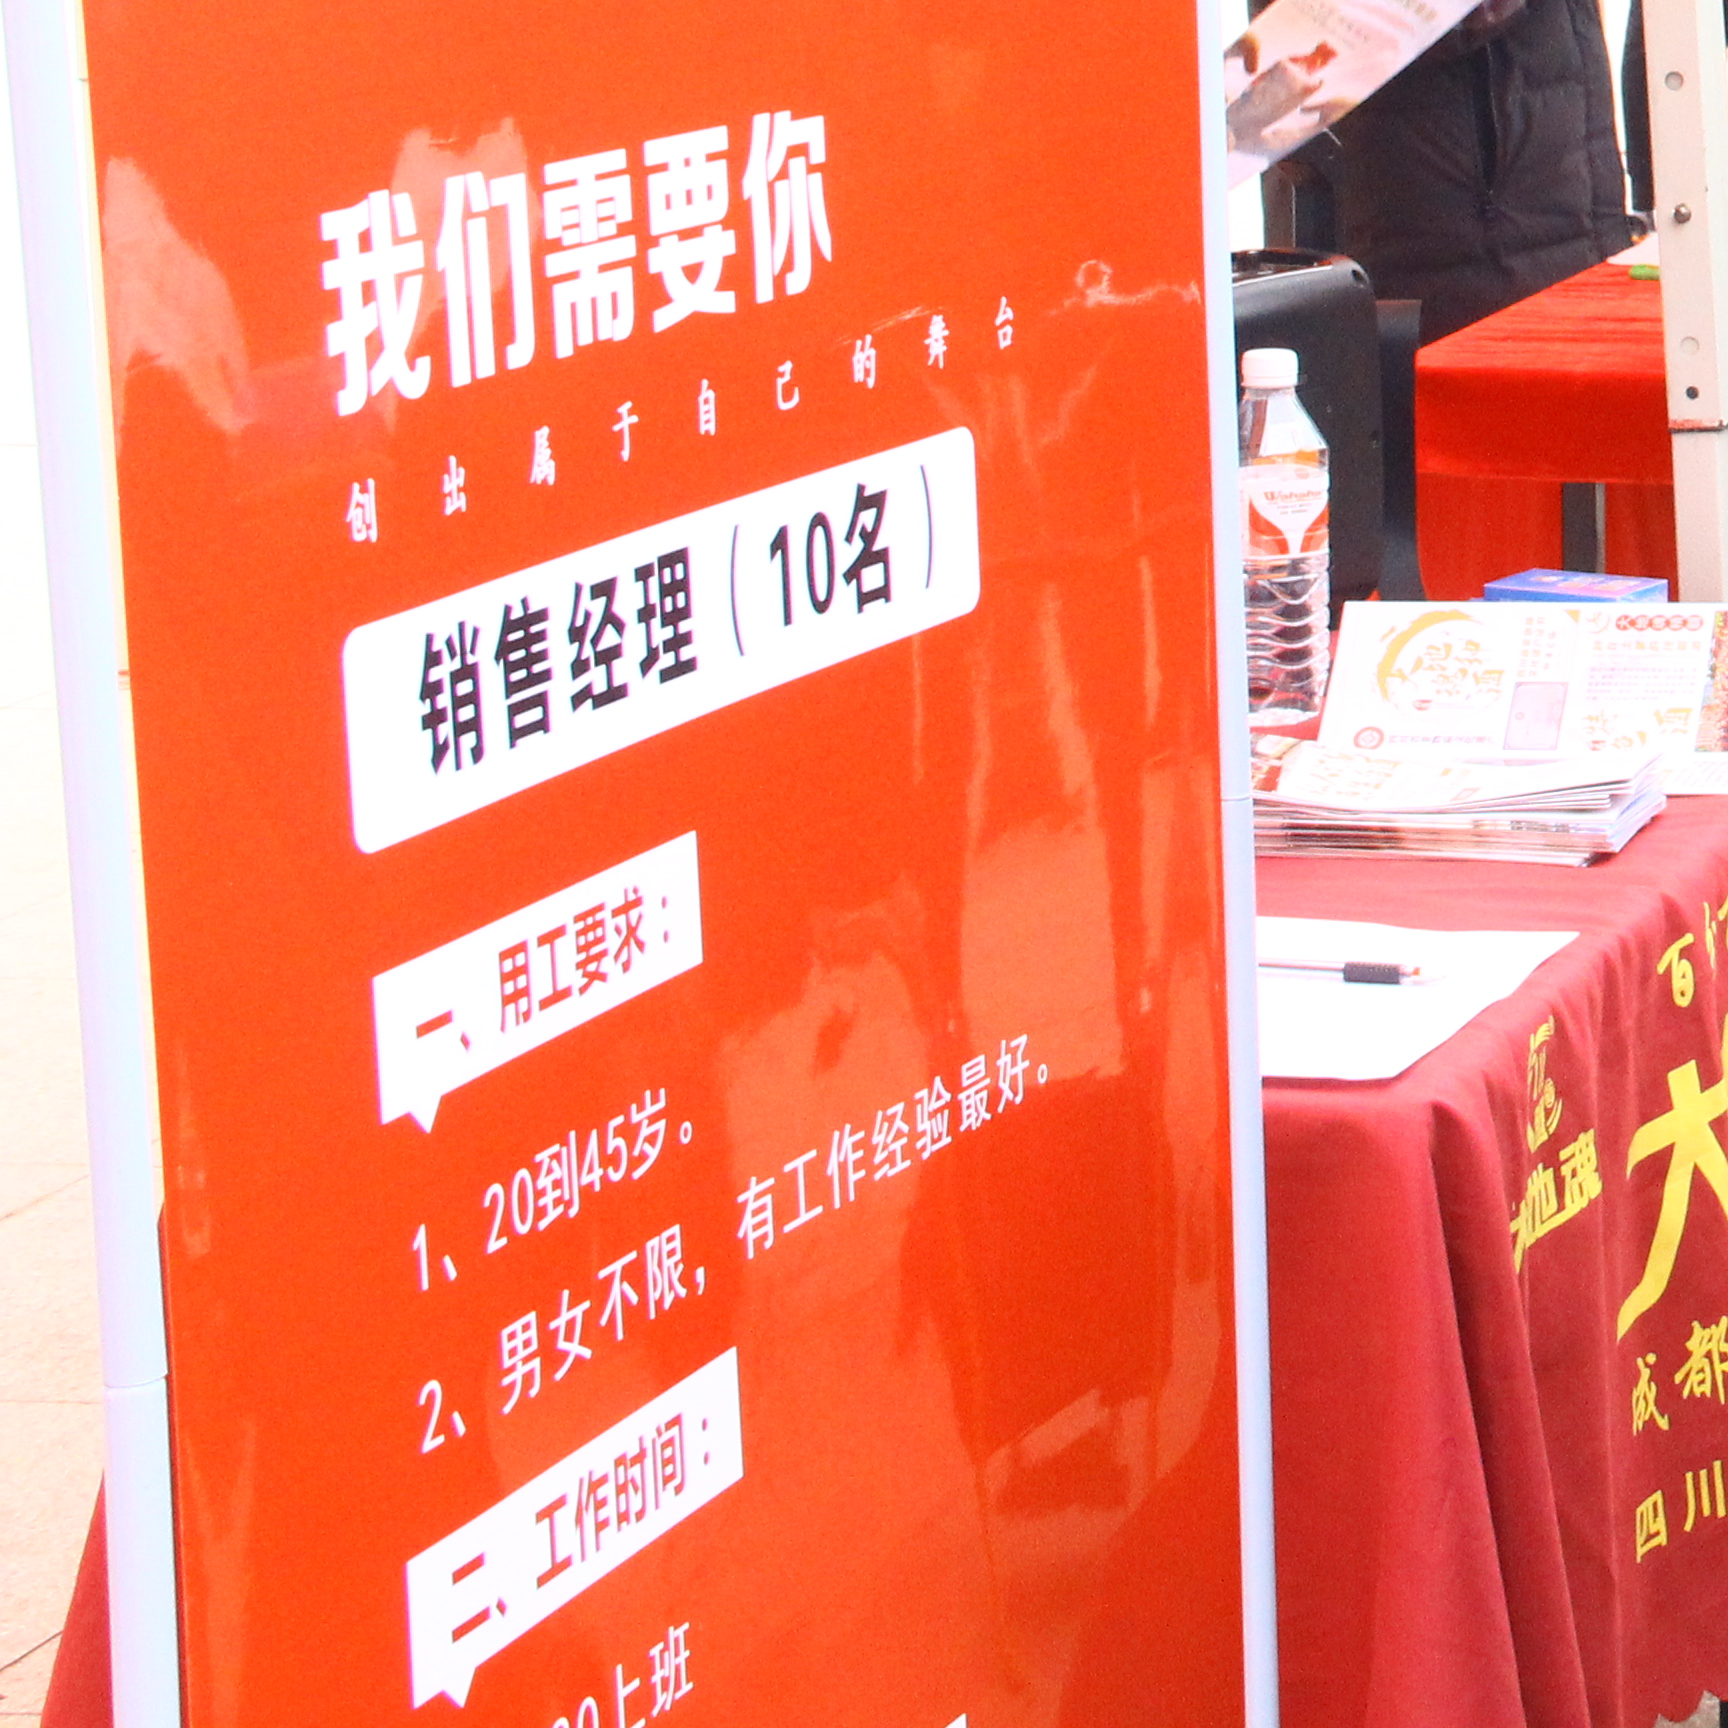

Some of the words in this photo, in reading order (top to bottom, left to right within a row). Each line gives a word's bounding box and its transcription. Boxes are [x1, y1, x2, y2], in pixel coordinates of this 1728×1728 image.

[317, 108, 834, 418] 我们需要你
[344, 295, 1017, 546] 创出属于自己的舞台
[416, 463, 934, 776] 销售经理（10名）
[413, 886, 673, 1053] 一、用工要求：
[410, 1087, 695, 1293] 1、20到45岁。
[418, 1032, 1051, 1456] 2、男女不限，有工作经验最好。
[448, 1412, 716, 1646] 二、工作时间：
